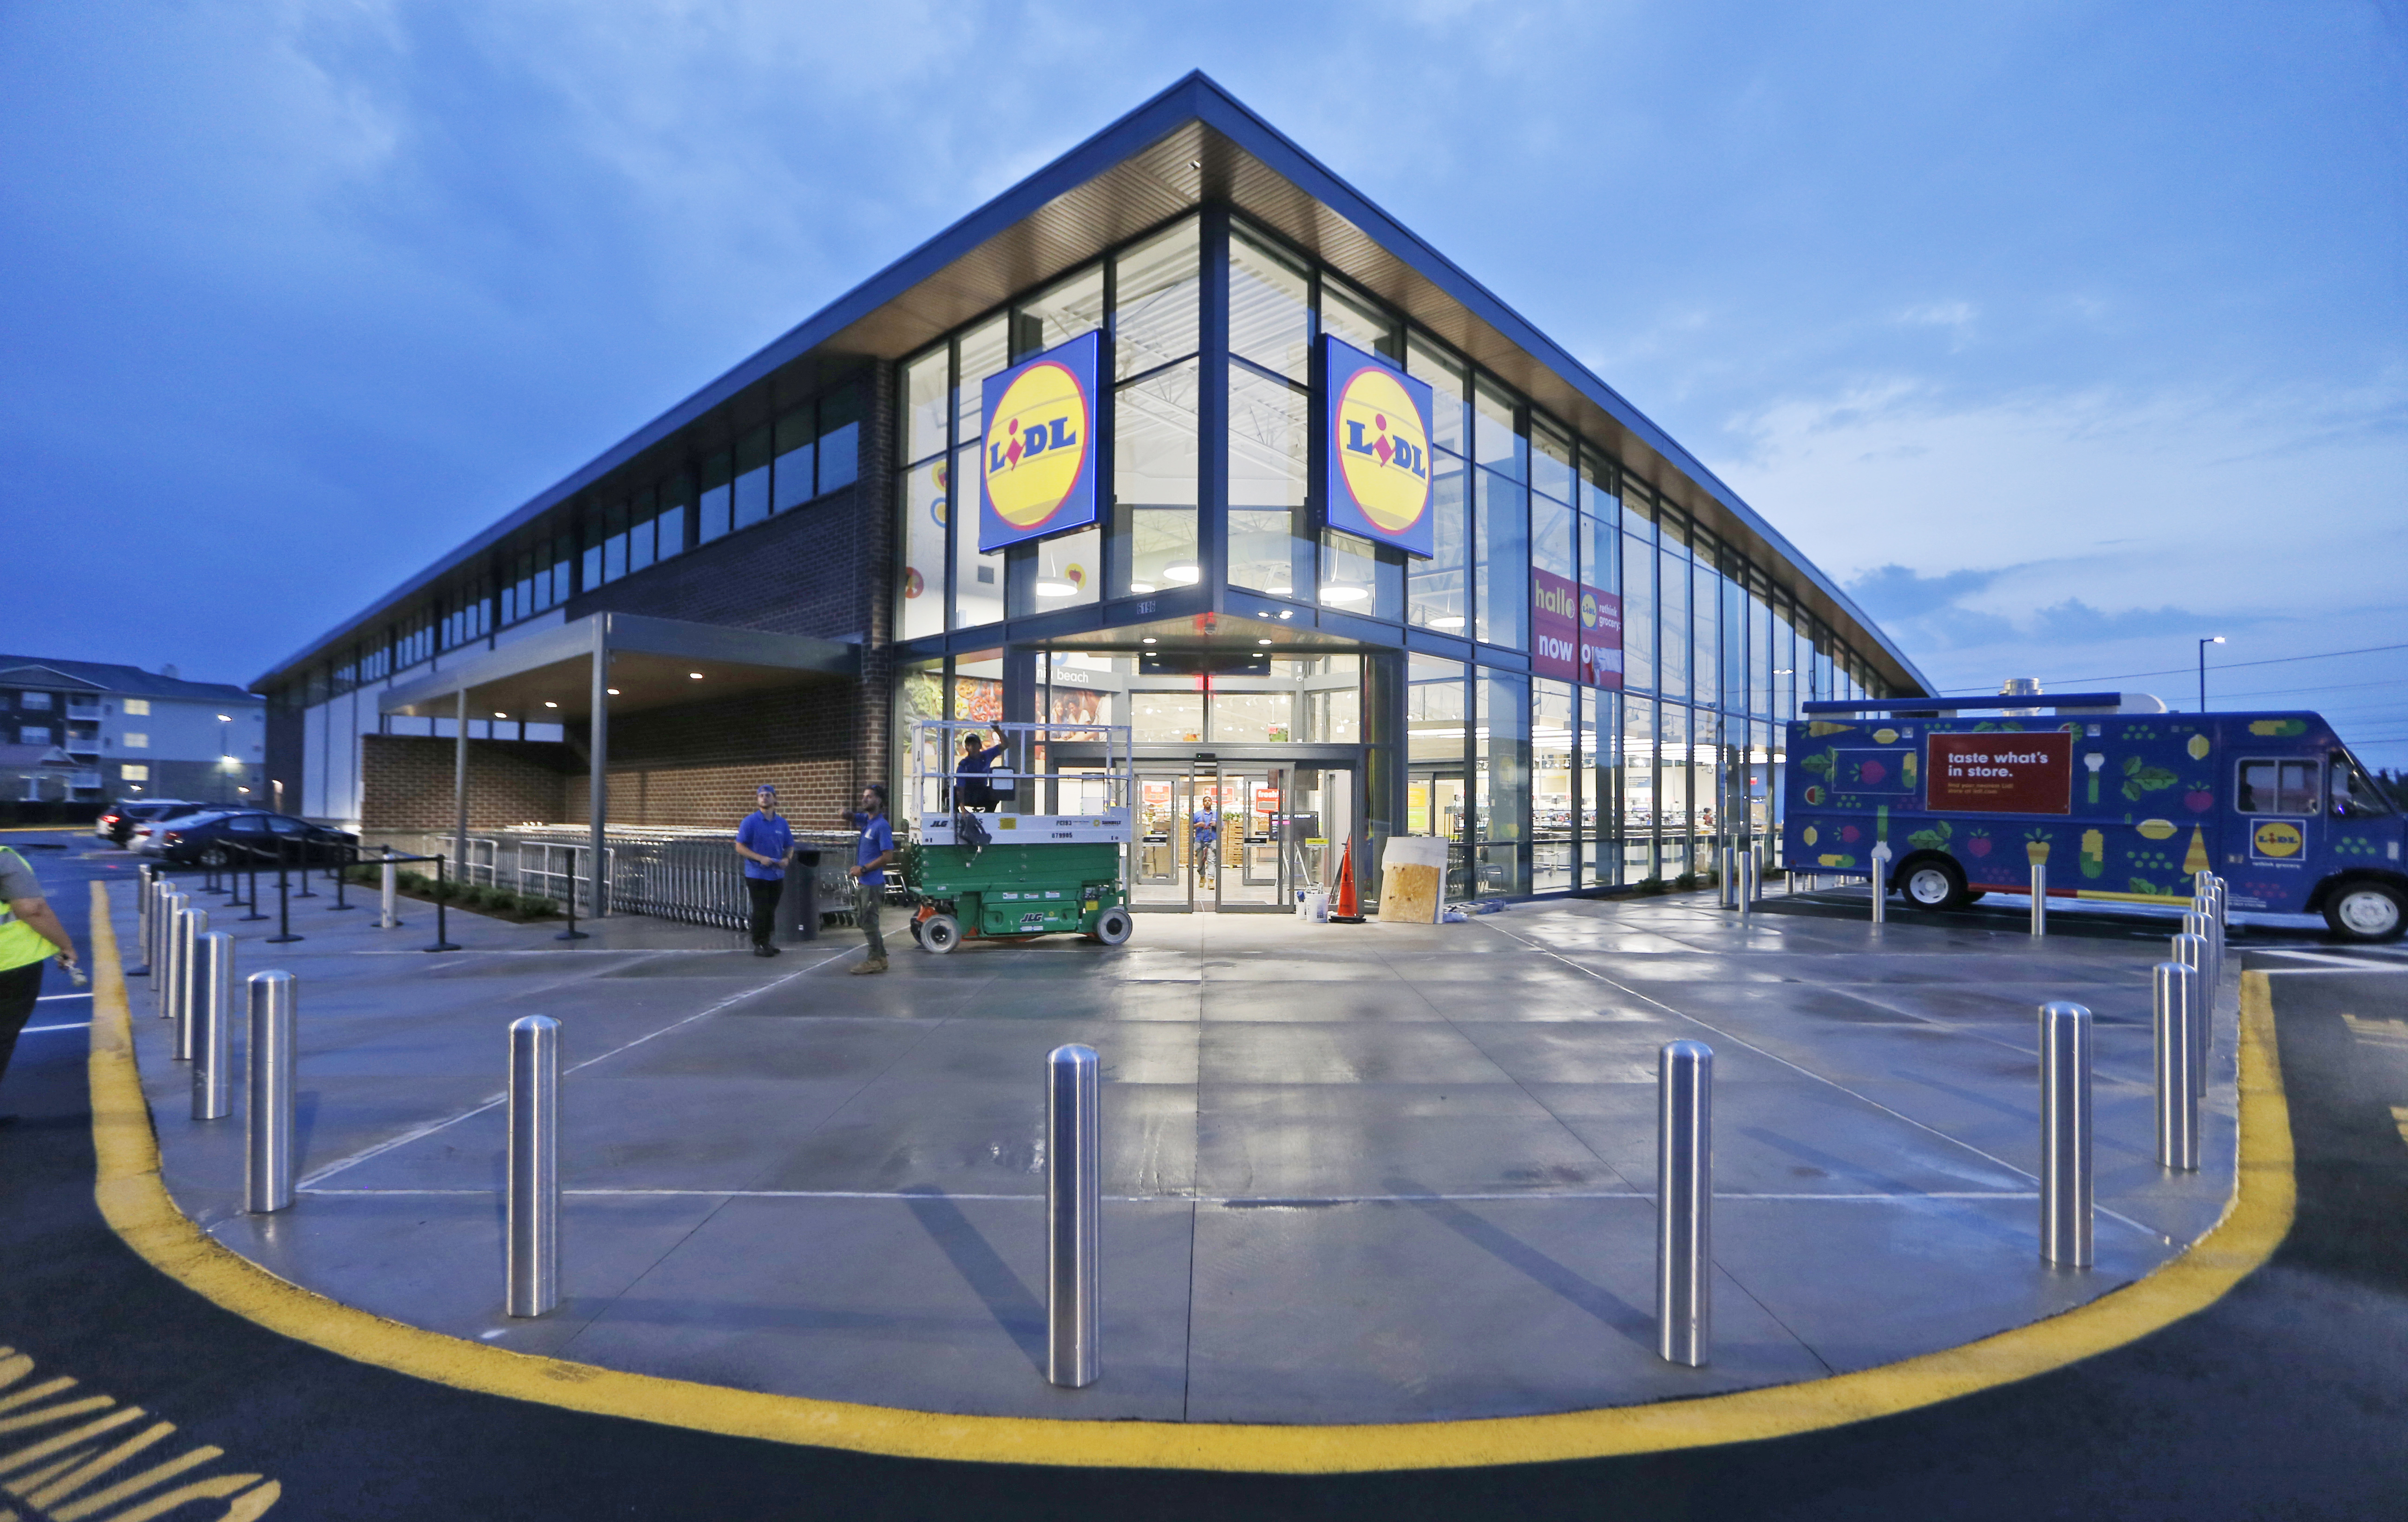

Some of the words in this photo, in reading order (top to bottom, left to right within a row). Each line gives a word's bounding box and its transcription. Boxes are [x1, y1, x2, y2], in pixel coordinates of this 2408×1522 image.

[1535, 579, 1575, 619] hallo
[1138, 601, 1155, 614] 6196
[1599, 604, 1617, 617] rethink
[1539, 635, 1573, 662] now
[1057, 668, 1089, 683] beach
[1948, 753, 1989, 763] taste
[1994, 751, 2048, 763] what's
[1948, 765, 1962, 776] in
[1968, 766, 2014, 777] store.
[1020, 912, 1044, 923] JLG
